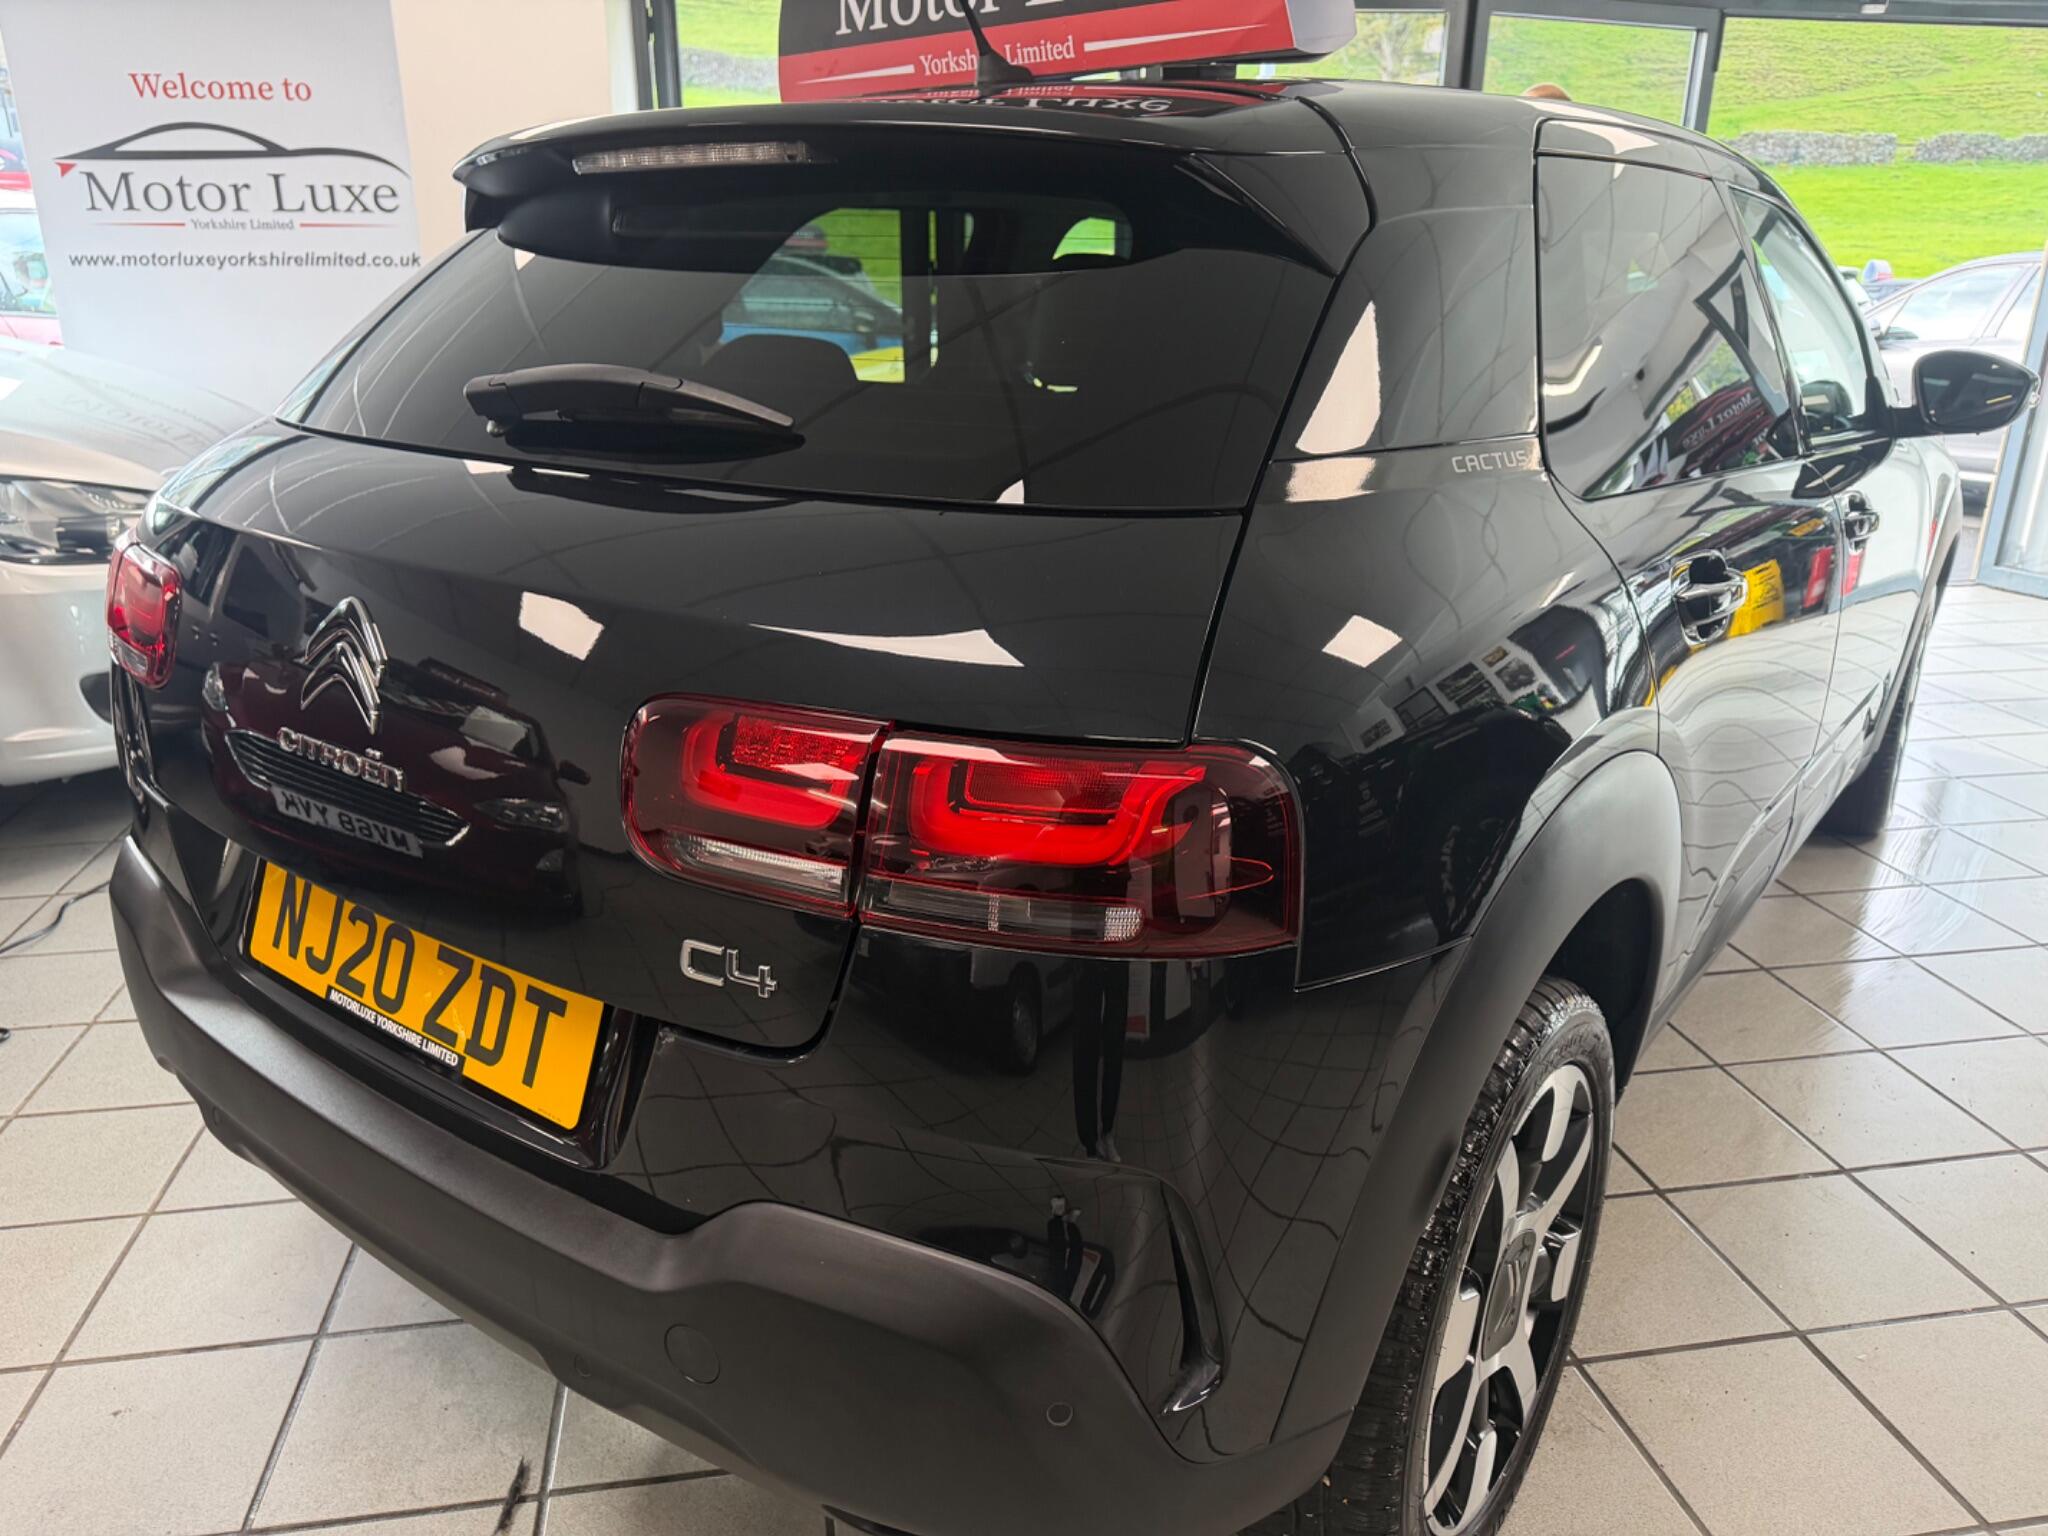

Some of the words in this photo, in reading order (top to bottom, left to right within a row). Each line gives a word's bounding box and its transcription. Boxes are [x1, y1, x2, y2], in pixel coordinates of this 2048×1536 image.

[918, 49, 978, 76] Yorksh
[1004, 35, 1076, 66] Limited
[129, 72, 273, 101] Welcome
[282, 78, 312, 102] to
[80, 171, 251, 213] Motor
[268, 172, 400, 214] Luxe
[191, 218, 248, 232] Yorkshire
[250, 218, 295, 231] Limited
[69, 250, 421, 270] www.motorluxeyorkshirelimited.co.uk
[1451, 450, 1528, 473] CACTUS
[277, 726, 404, 793] CITROËN
[271, 872, 415, 1015] NJ20
[422, 946, 568, 1088] ZDT
[680, 938, 778, 998] C4
[329, 989, 376, 1023] MOTORLUXE
[376, 1013, 422, 1049] YORKSHIRE
[422, 1038, 459, 1067] LIMITED
